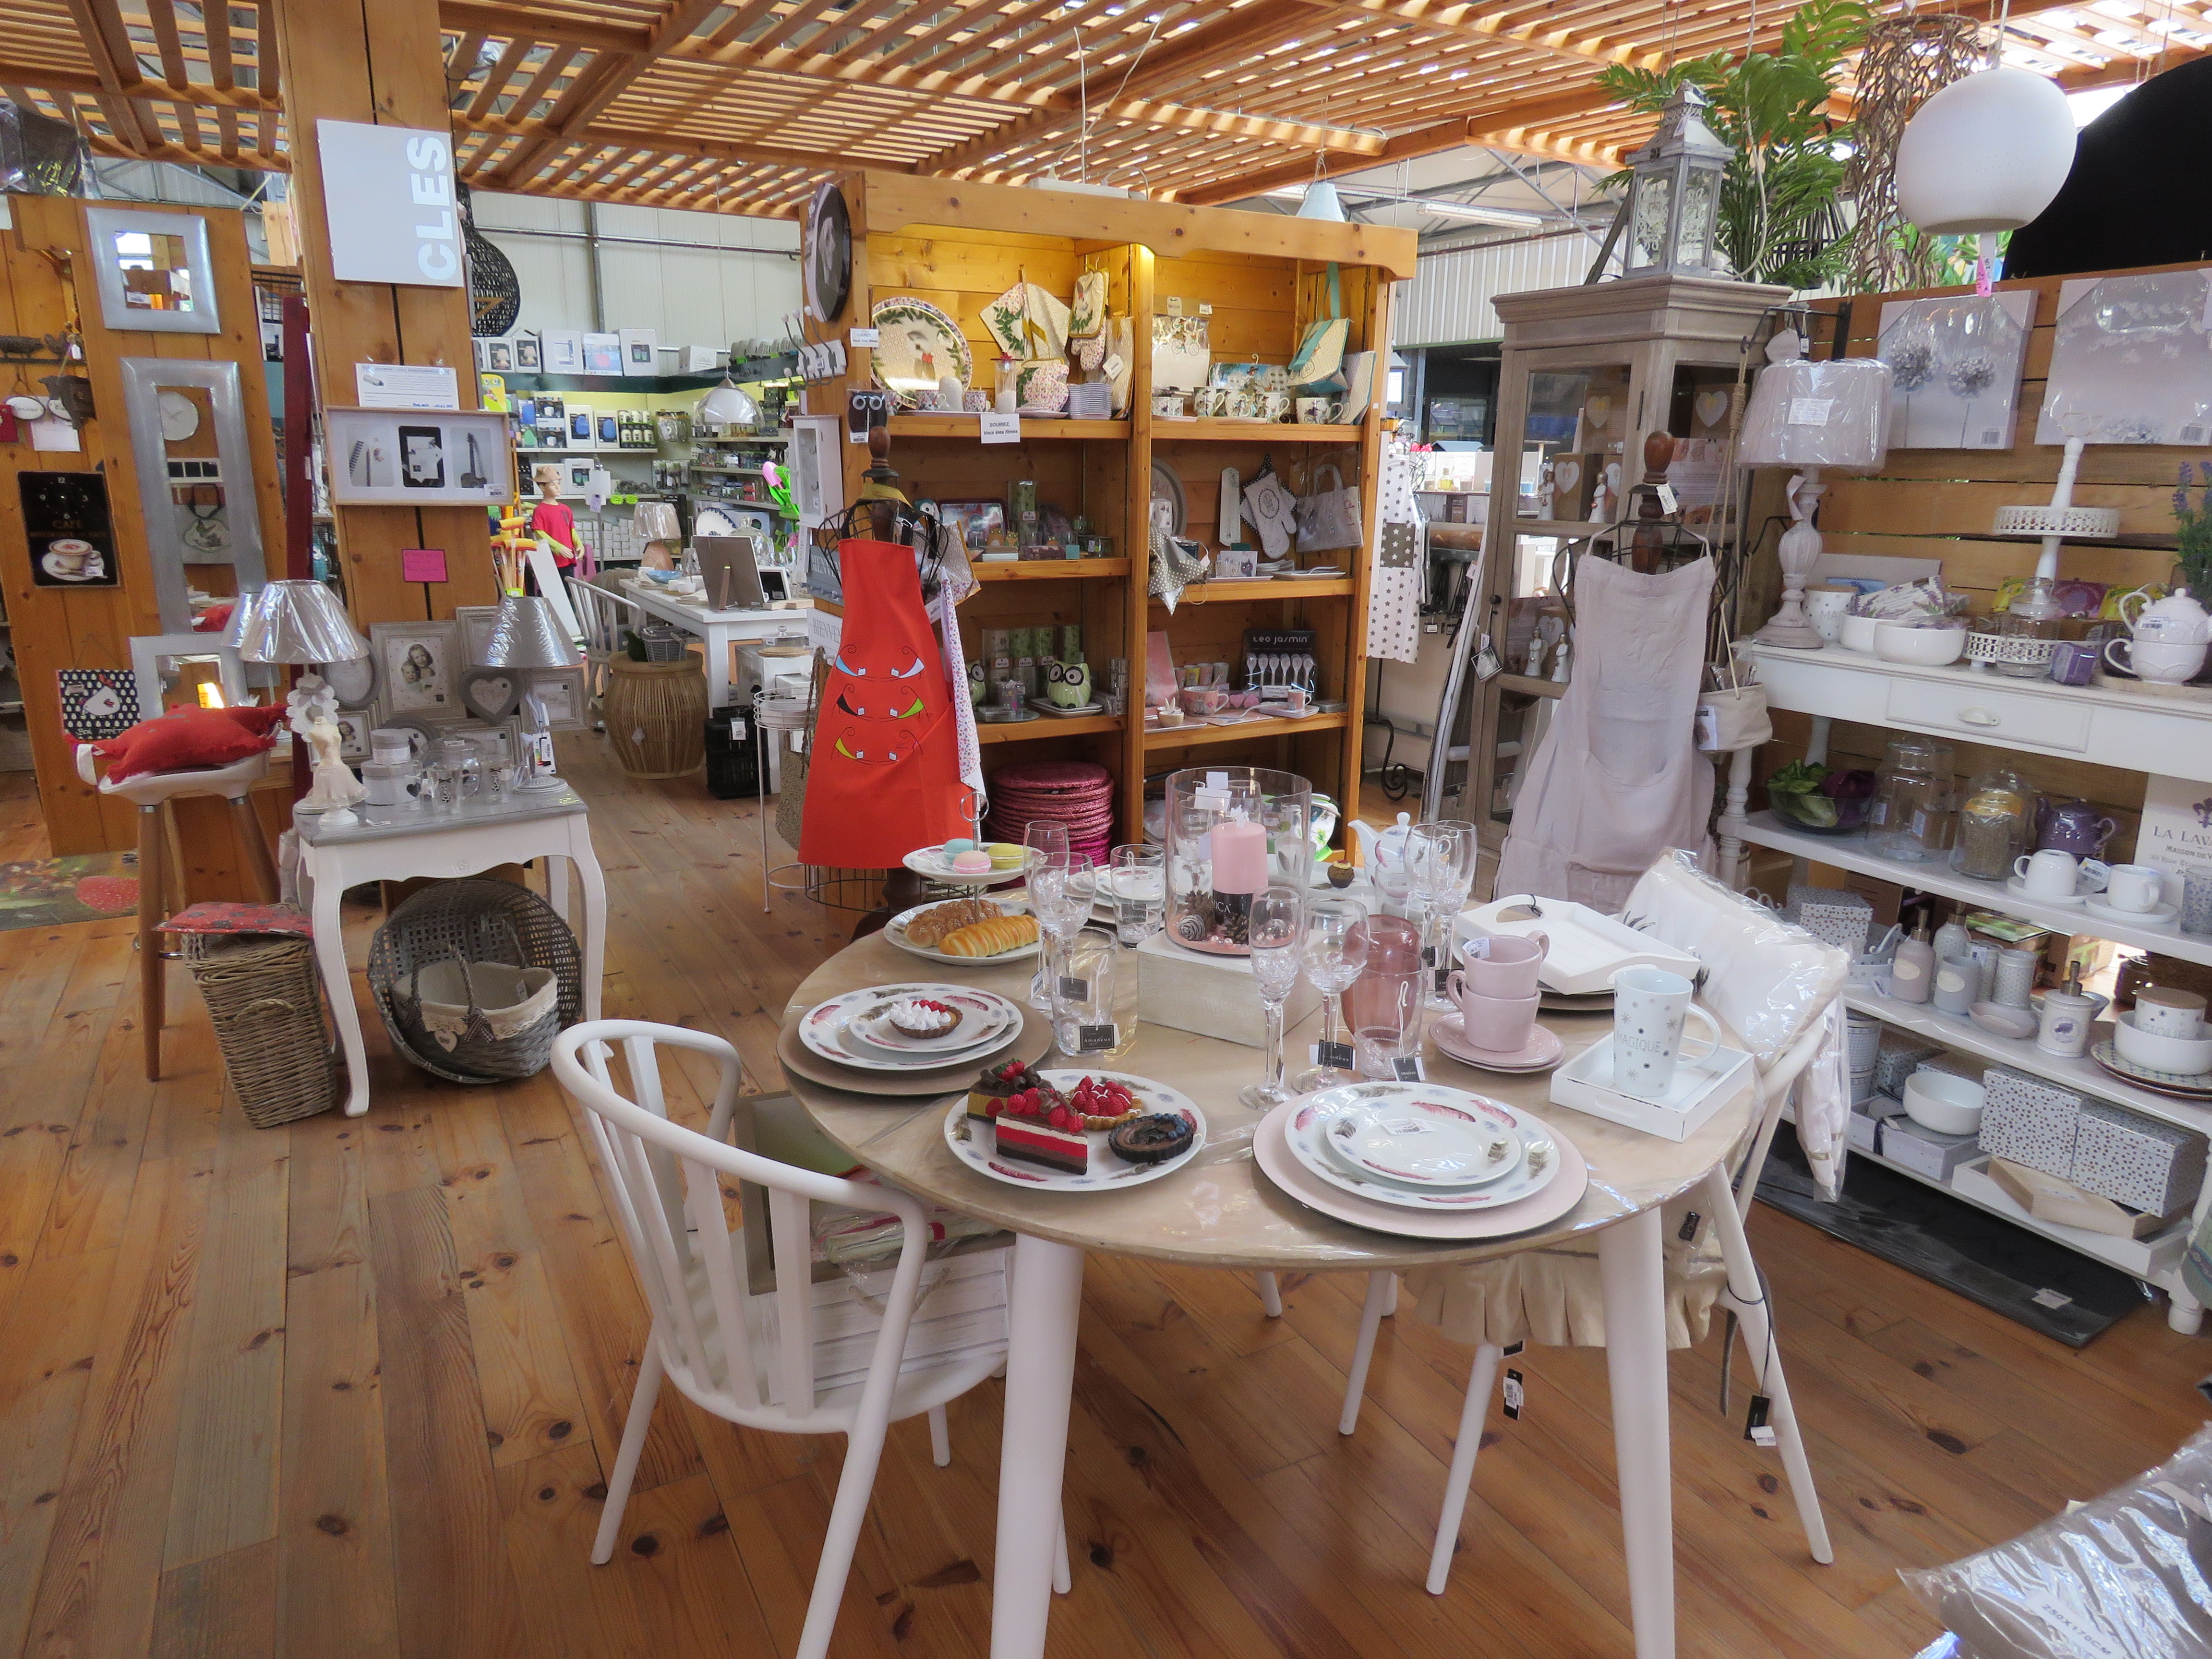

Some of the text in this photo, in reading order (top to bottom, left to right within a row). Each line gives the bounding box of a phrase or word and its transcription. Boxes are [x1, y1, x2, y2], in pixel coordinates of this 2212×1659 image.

[406, 136, 457, 281] CLES
[1273, 636, 1308, 645] jasmin
[2153, 826, 2212, 846] LA LAV
[1616, 1030, 1661, 1053] MAGIQUE
